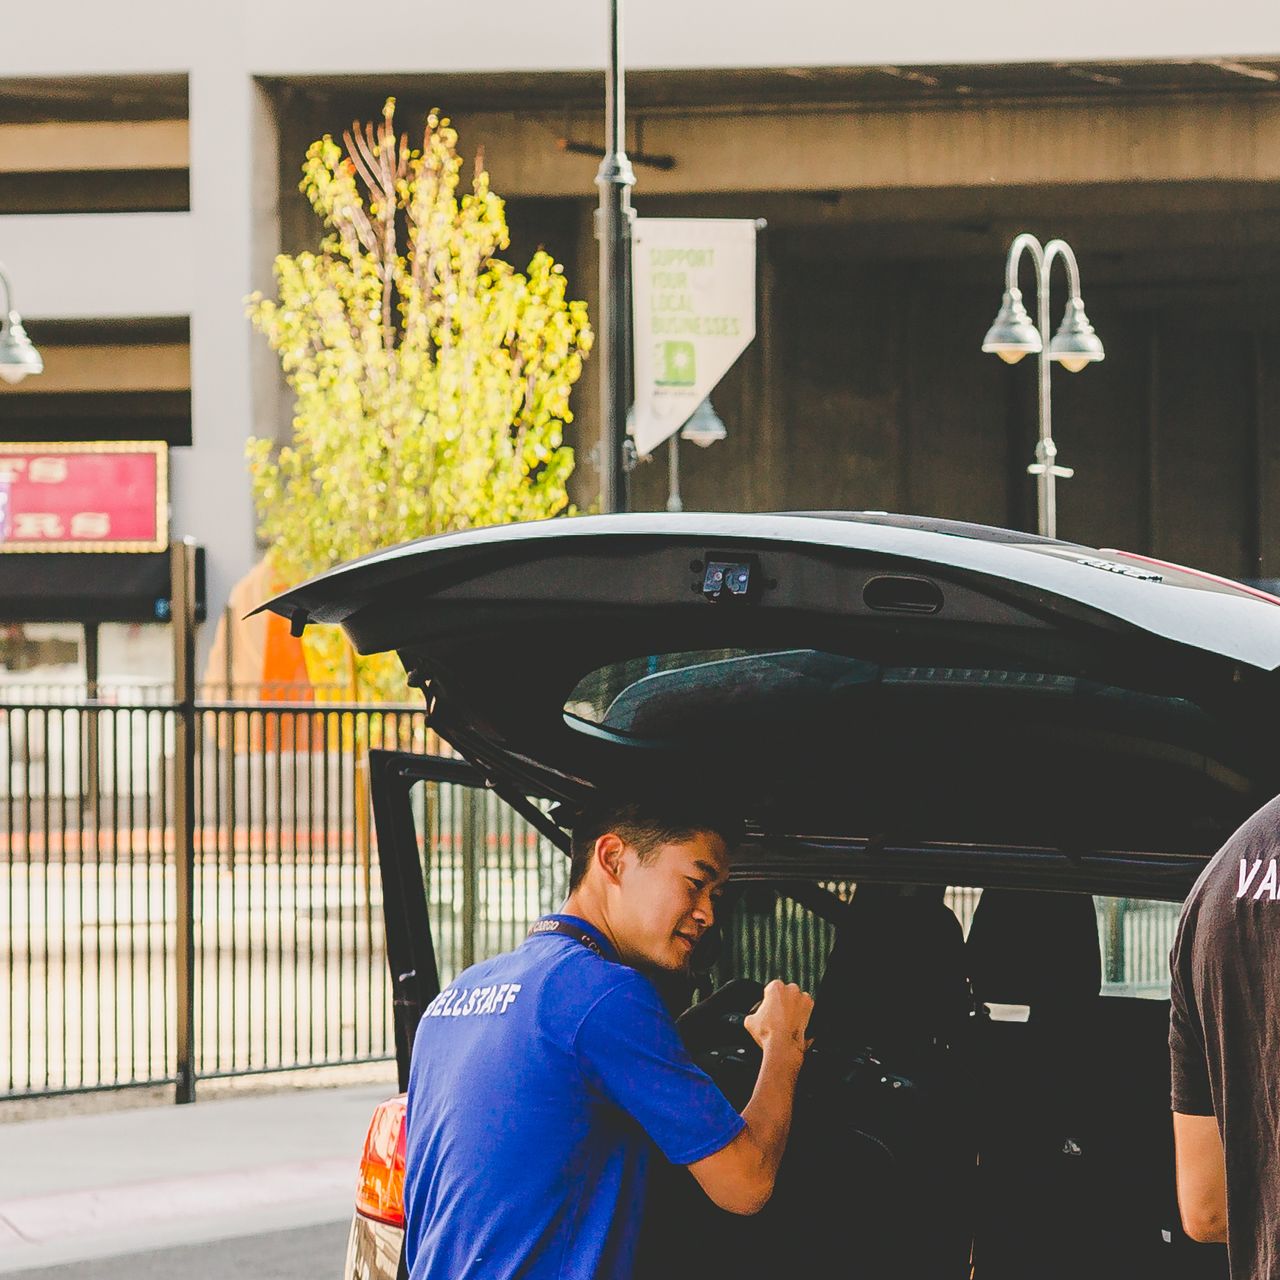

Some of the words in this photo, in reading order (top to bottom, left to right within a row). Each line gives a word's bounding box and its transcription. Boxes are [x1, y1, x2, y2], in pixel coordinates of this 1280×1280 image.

[650, 248, 715, 267] SUPPORT
[651, 272, 688, 289] YOUR
[651, 293, 694, 312] LOCAL
[651, 315, 741, 336] BUSINESSES
